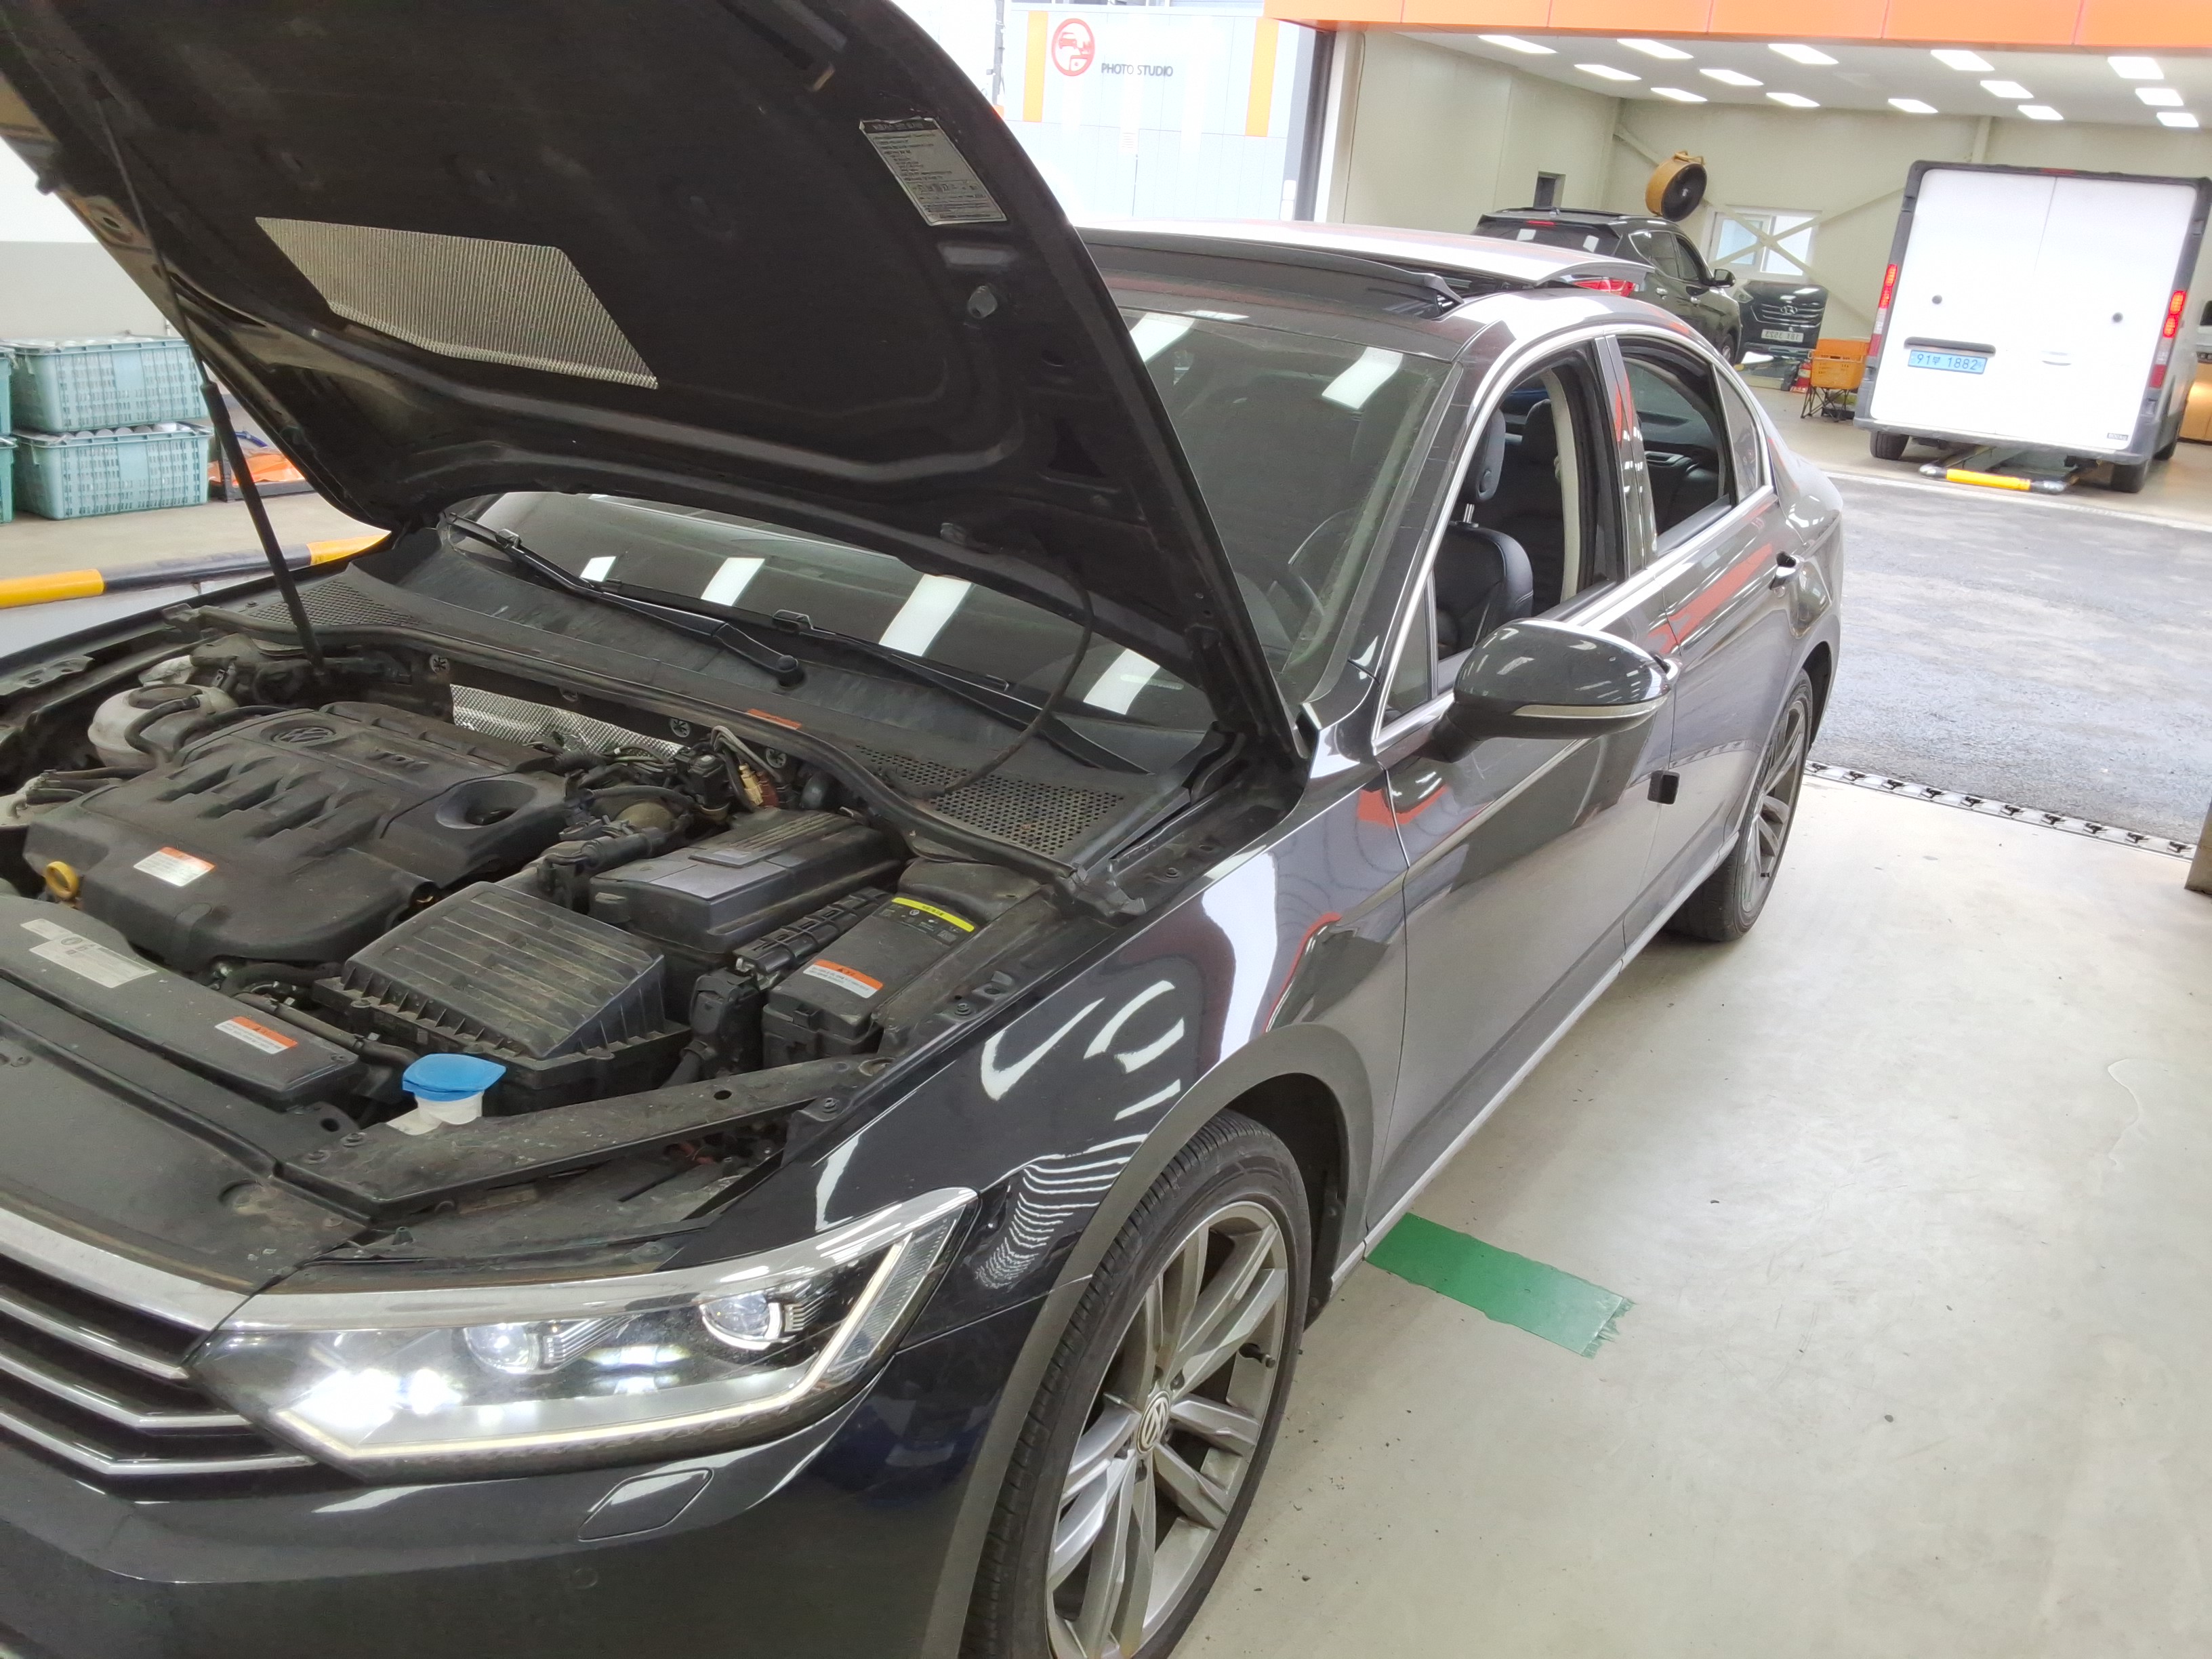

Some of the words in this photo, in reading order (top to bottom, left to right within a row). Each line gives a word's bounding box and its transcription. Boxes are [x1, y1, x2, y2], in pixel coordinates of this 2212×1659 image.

[1101, 63, 1134, 75] PHOTO
[1137, 65, 1174, 77] STUDIO
[1948, 356, 1978, 370] 1882
